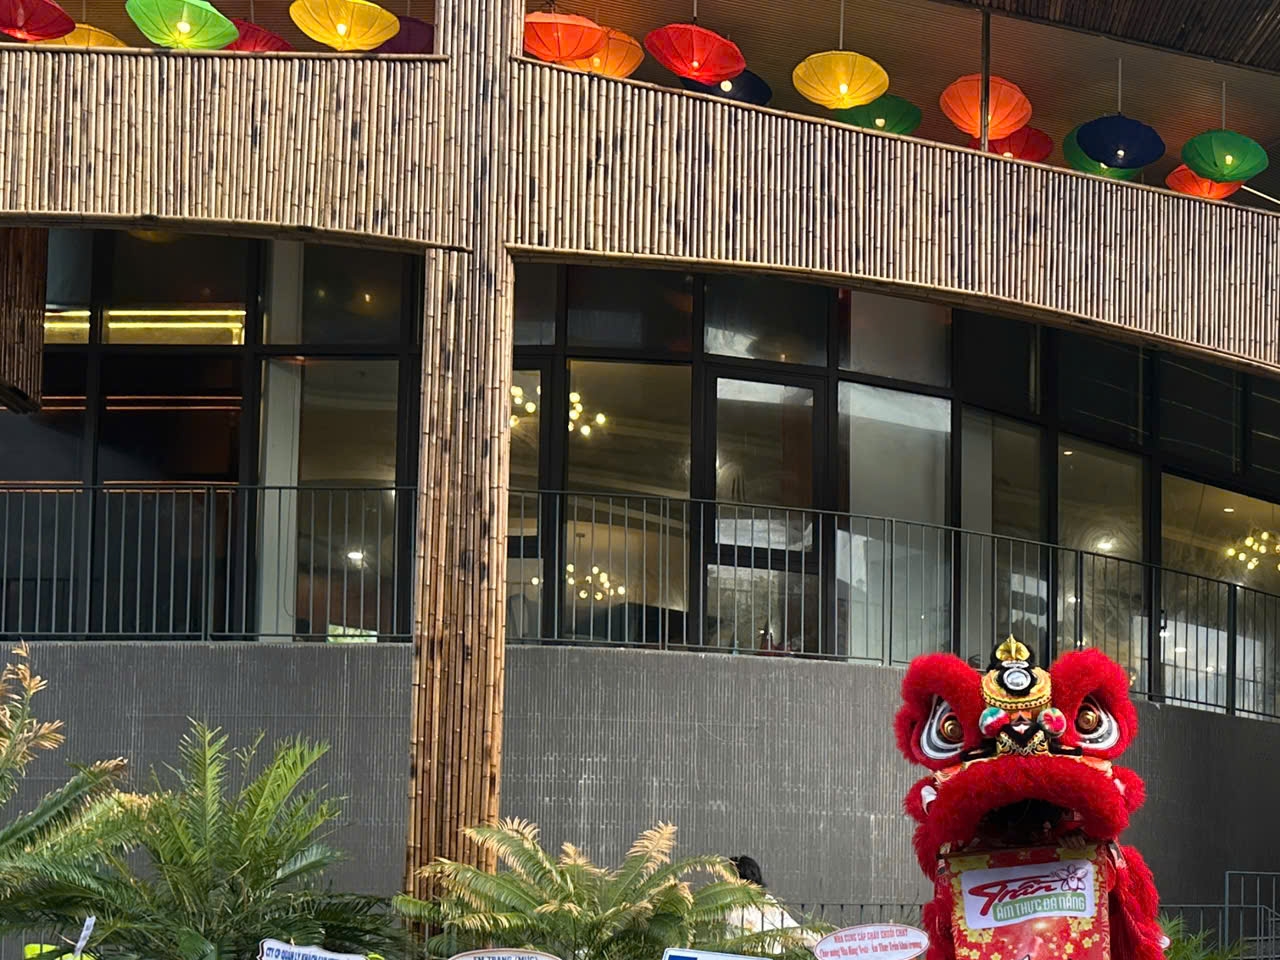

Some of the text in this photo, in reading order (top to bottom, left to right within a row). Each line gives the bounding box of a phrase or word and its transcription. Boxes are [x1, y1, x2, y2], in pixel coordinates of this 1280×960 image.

[996, 893, 1085, 920] ẨM THỰC ĐÀ NẴNG
